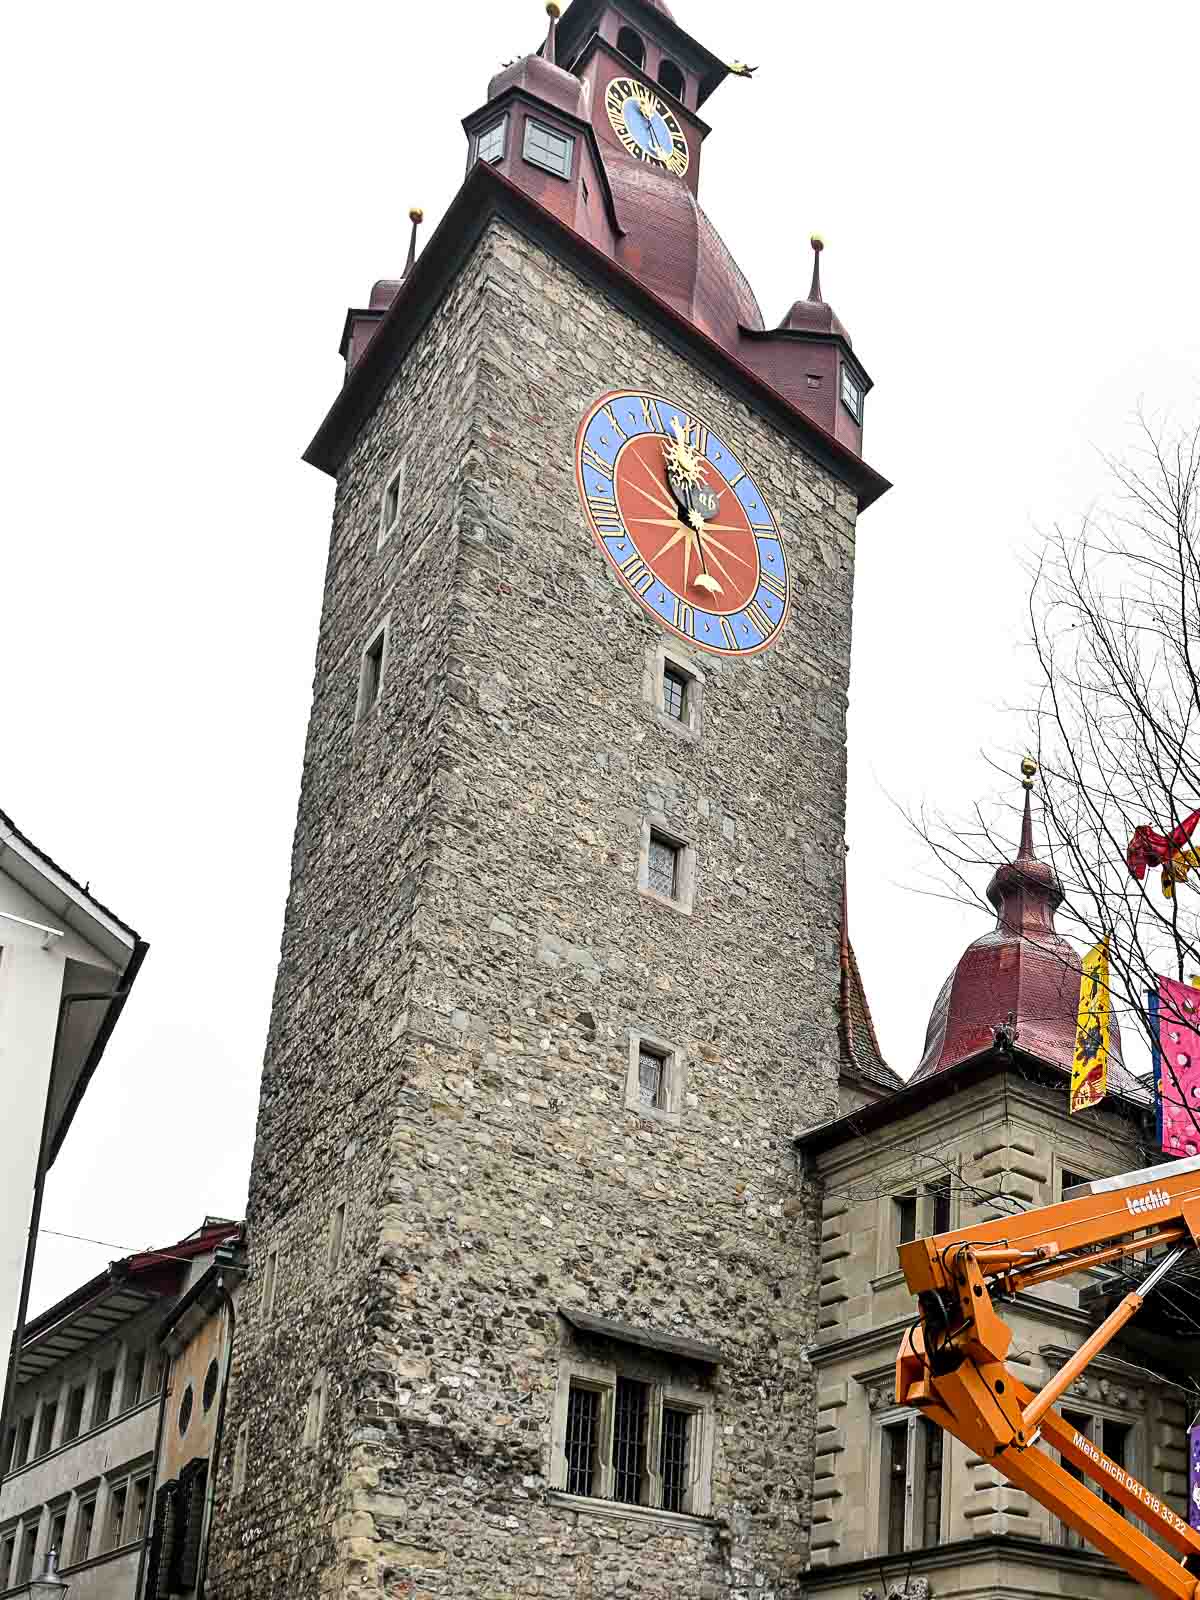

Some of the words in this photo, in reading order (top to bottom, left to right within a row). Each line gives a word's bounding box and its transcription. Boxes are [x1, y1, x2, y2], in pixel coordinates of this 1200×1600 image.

[1073, 1432, 1099, 1460] Miete
[1126, 1478, 1142, 1497] 041
[1144, 1494, 1160, 1513] 318
[1161, 1507, 1173, 1525] 33
